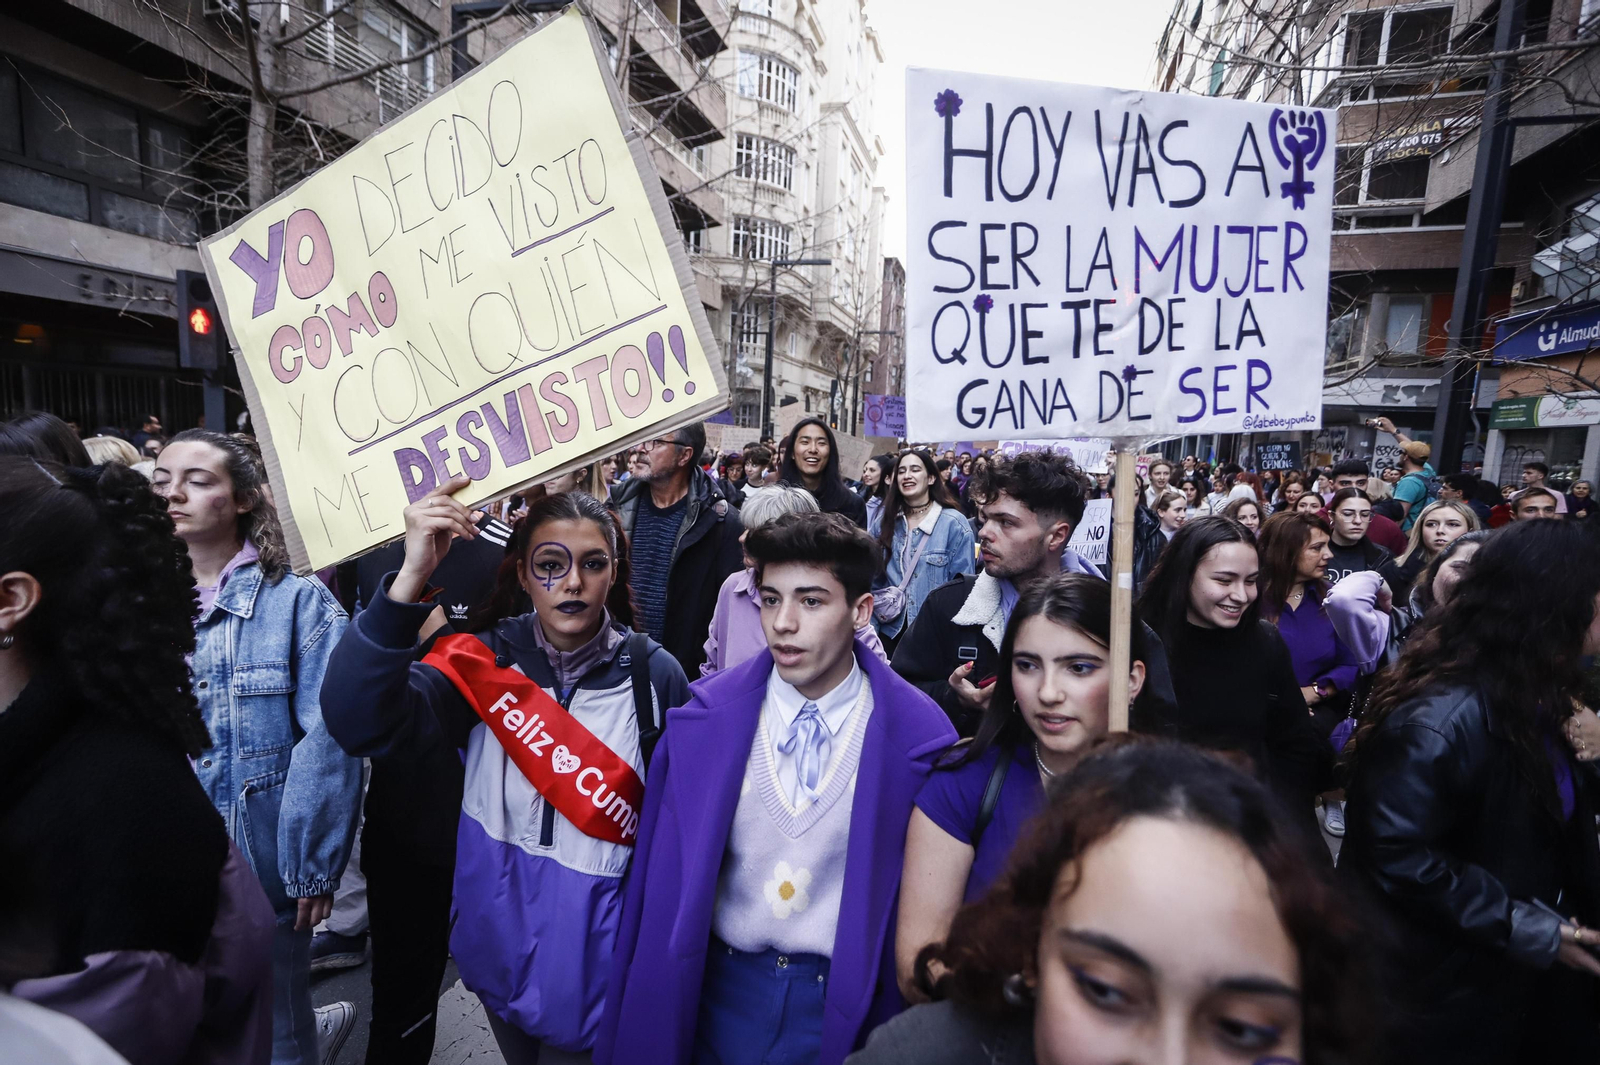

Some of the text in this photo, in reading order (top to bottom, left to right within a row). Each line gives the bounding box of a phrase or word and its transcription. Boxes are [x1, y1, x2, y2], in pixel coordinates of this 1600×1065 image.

[943, 97, 1271, 212] HOY VAS A
[1421, 132, 1442, 145] 075
[229, 208, 334, 319] YO
[928, 220, 1308, 298] SER LA MUJER
[268, 271, 398, 384] CÓMO
[419, 224, 473, 299] ME
[931, 297, 1267, 369] QUE TE DE LA
[1558, 320, 1600, 344] Almud
[288, 393, 305, 452] Y
[333, 322, 460, 443] CON
[956, 359, 1273, 430] GANA DE SER
[314, 324, 696, 548] ME DESVISTO!!
[1086, 525, 1105, 541] NO
[1087, 506, 1107, 523] SER
[489, 691, 637, 840] Feliz Cump
